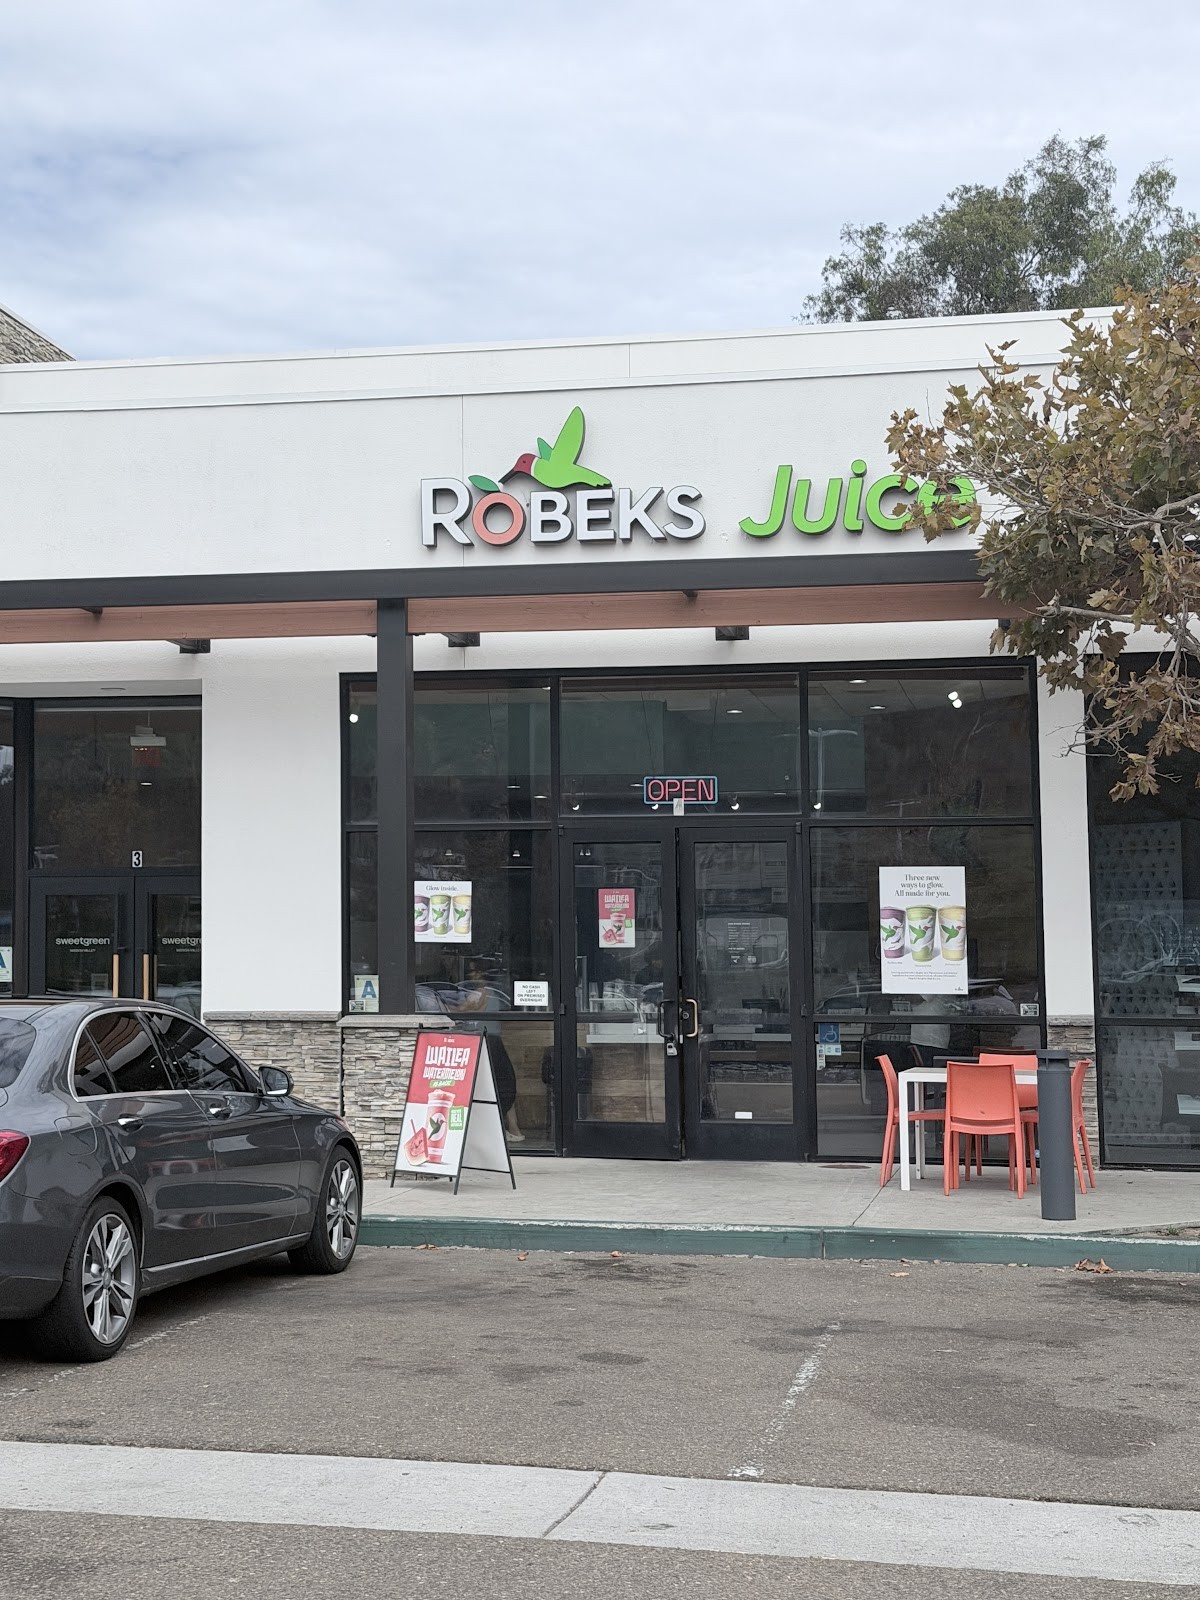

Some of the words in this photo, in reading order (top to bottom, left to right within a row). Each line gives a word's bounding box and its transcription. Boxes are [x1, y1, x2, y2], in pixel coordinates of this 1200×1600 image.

[420, 477, 705, 549] ROBEKS
[739, 459, 977, 538] Juice
[647, 778, 714, 801] OPEN
[133, 851, 141, 867] 3
[904, 873, 925, 881] Three
[894, 889, 905, 897] All
[905, 889, 924, 897] made
[925, 889, 936, 897] for
[936, 890, 951, 898] you.
[900, 882, 918, 890] ways
[55, 937, 110, 947] sweetgreen
[361, 980, 377, 999] A
[425, 1045, 471, 1067] WAILEA
